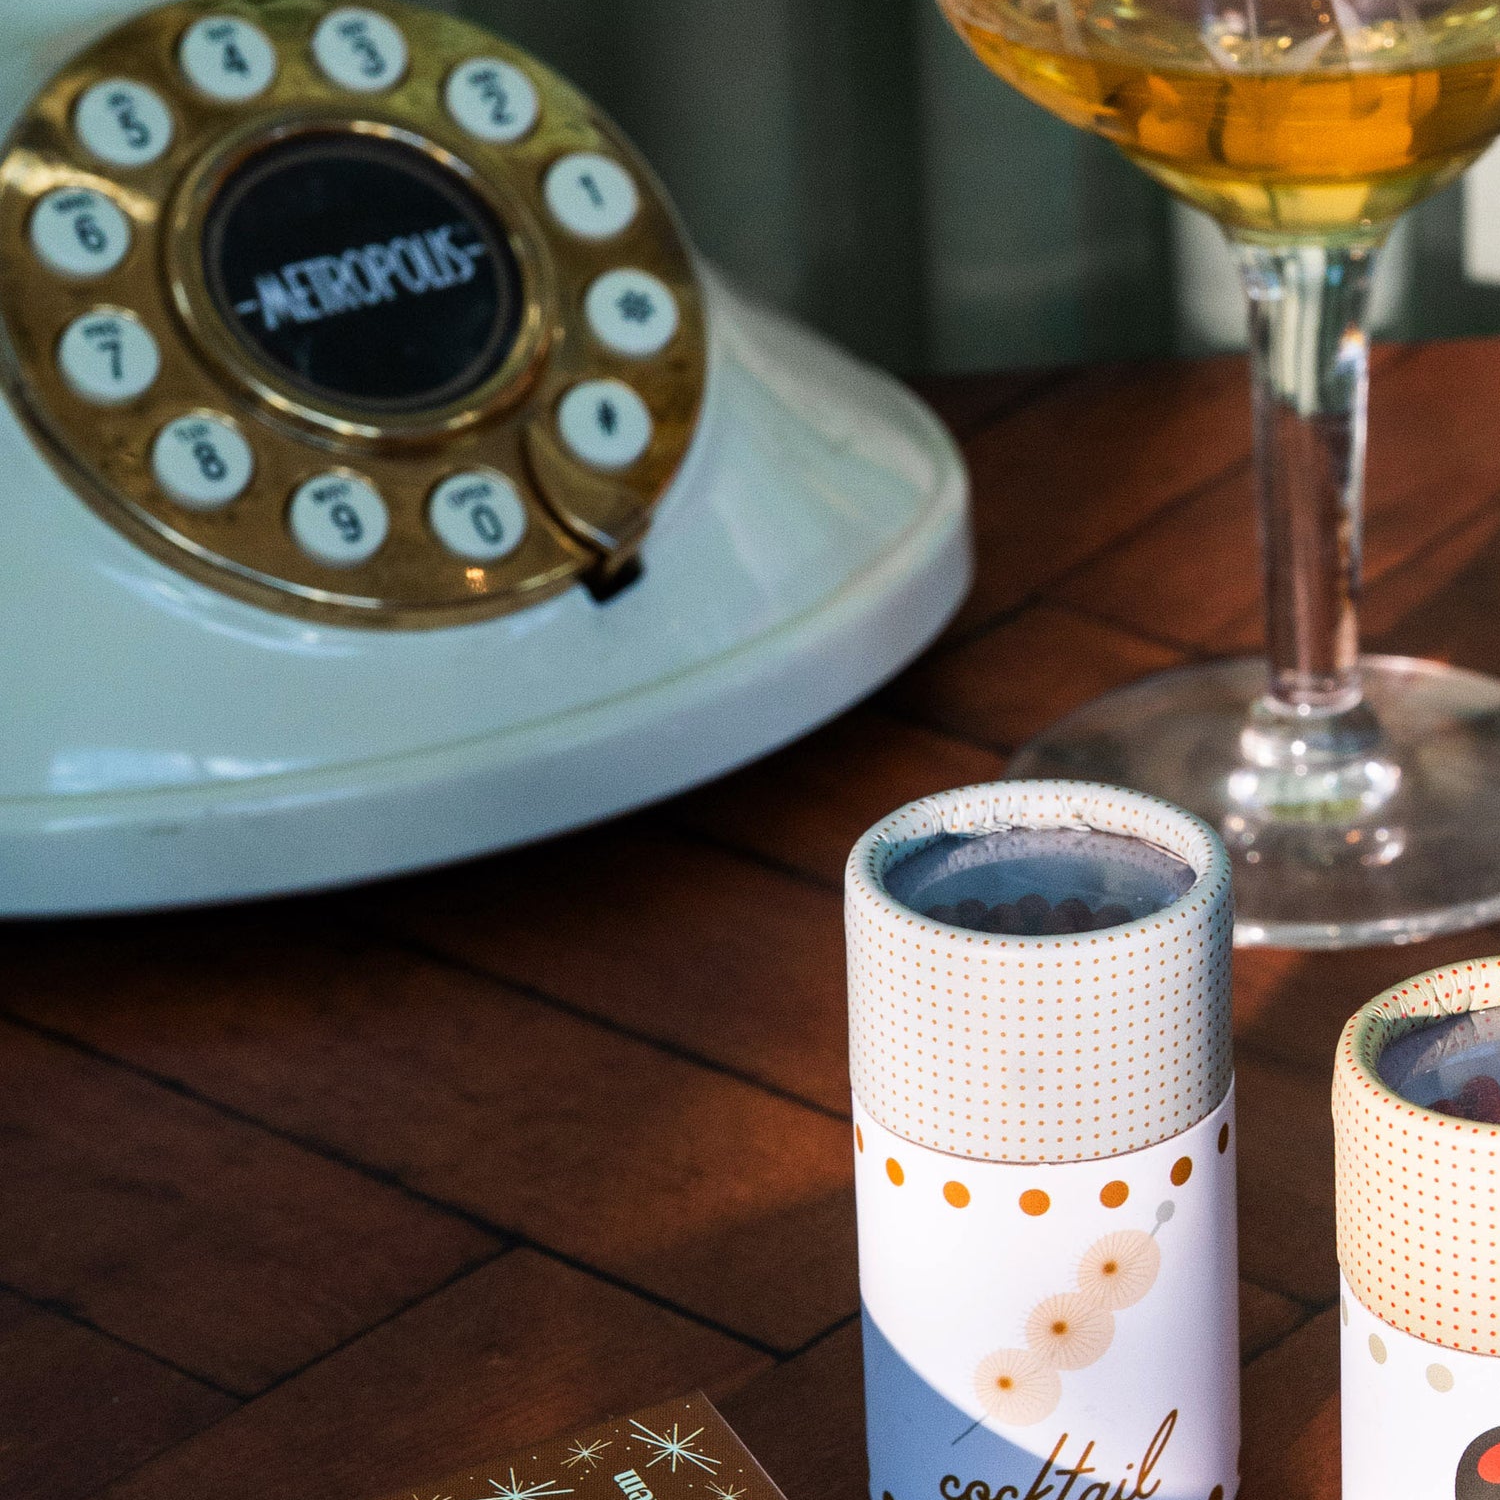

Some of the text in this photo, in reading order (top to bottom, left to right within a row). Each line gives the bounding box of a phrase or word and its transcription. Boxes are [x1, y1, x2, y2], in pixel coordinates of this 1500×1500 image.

[221, 42, 249, 79] 4
[352, 35, 387, 78] 3
[117, 108, 151, 150] 5
[578, 173, 604, 209] 1
[73, 212, 109, 254] 6
[96, 338, 124, 380] 7
[192, 440, 228, 484] 8
[329, 501, 365, 546] 9
[470, 503, 504, 546] 0
